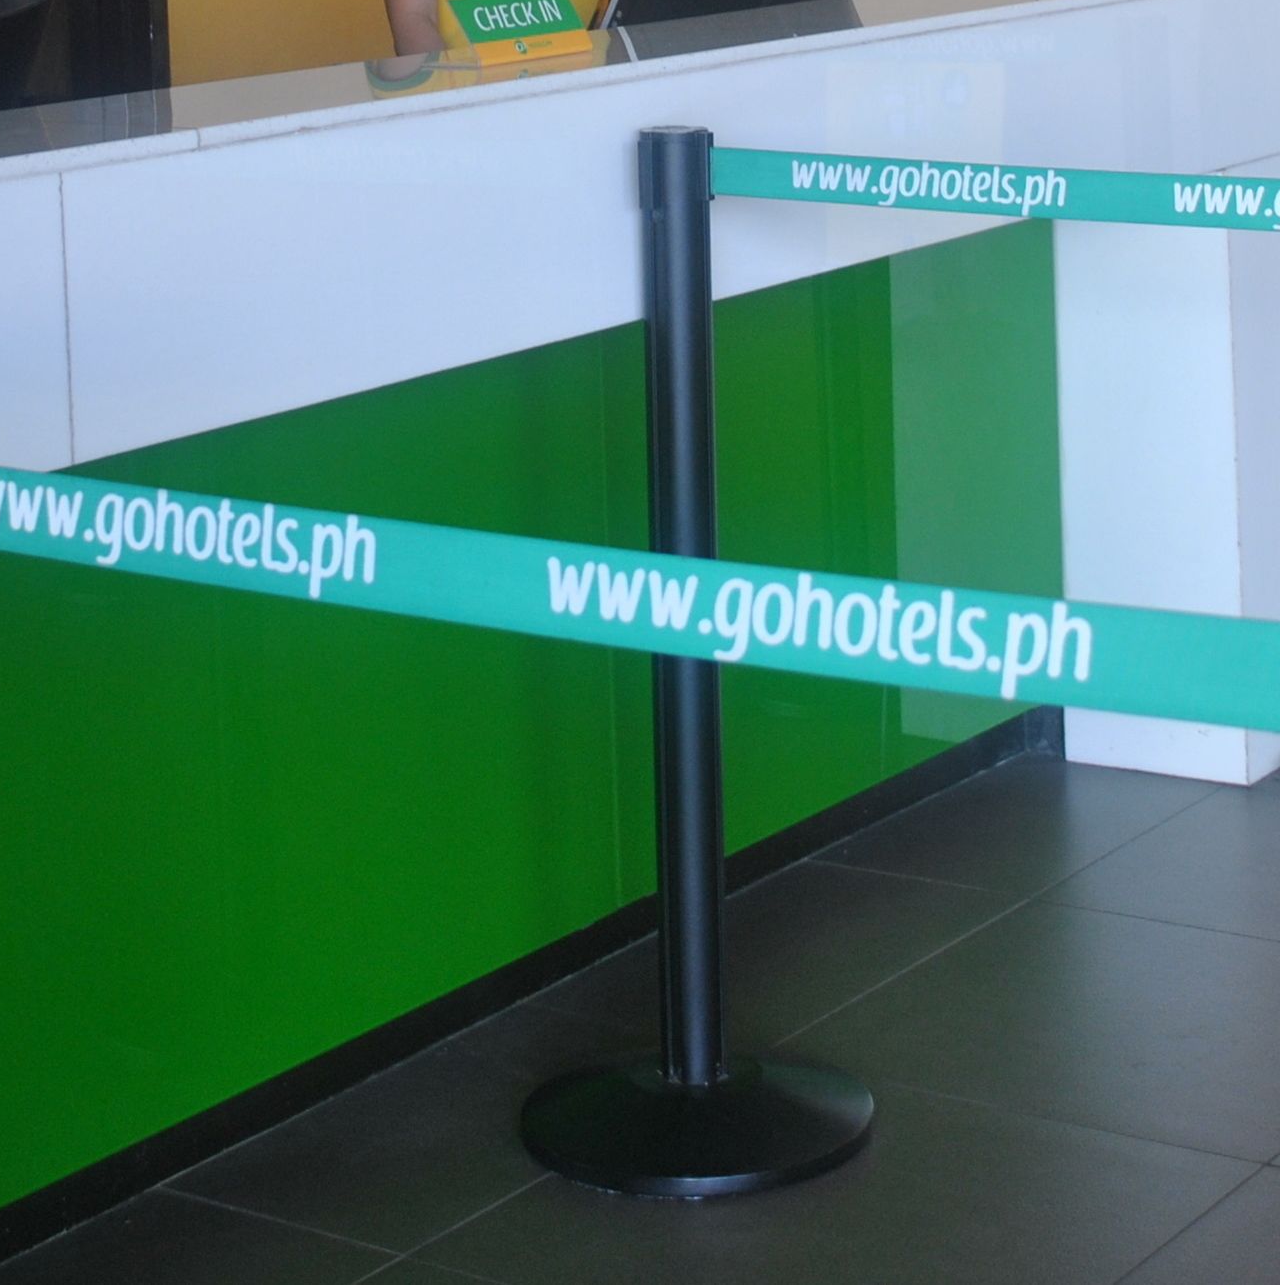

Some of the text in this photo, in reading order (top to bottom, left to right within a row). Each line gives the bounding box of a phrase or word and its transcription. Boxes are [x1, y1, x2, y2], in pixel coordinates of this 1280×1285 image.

[473, 2, 539, 32] CHECK
[791, 160, 1067, 216] www.gohotels.ph
[548, 555, 1094, 700] www.gohotels.ph
